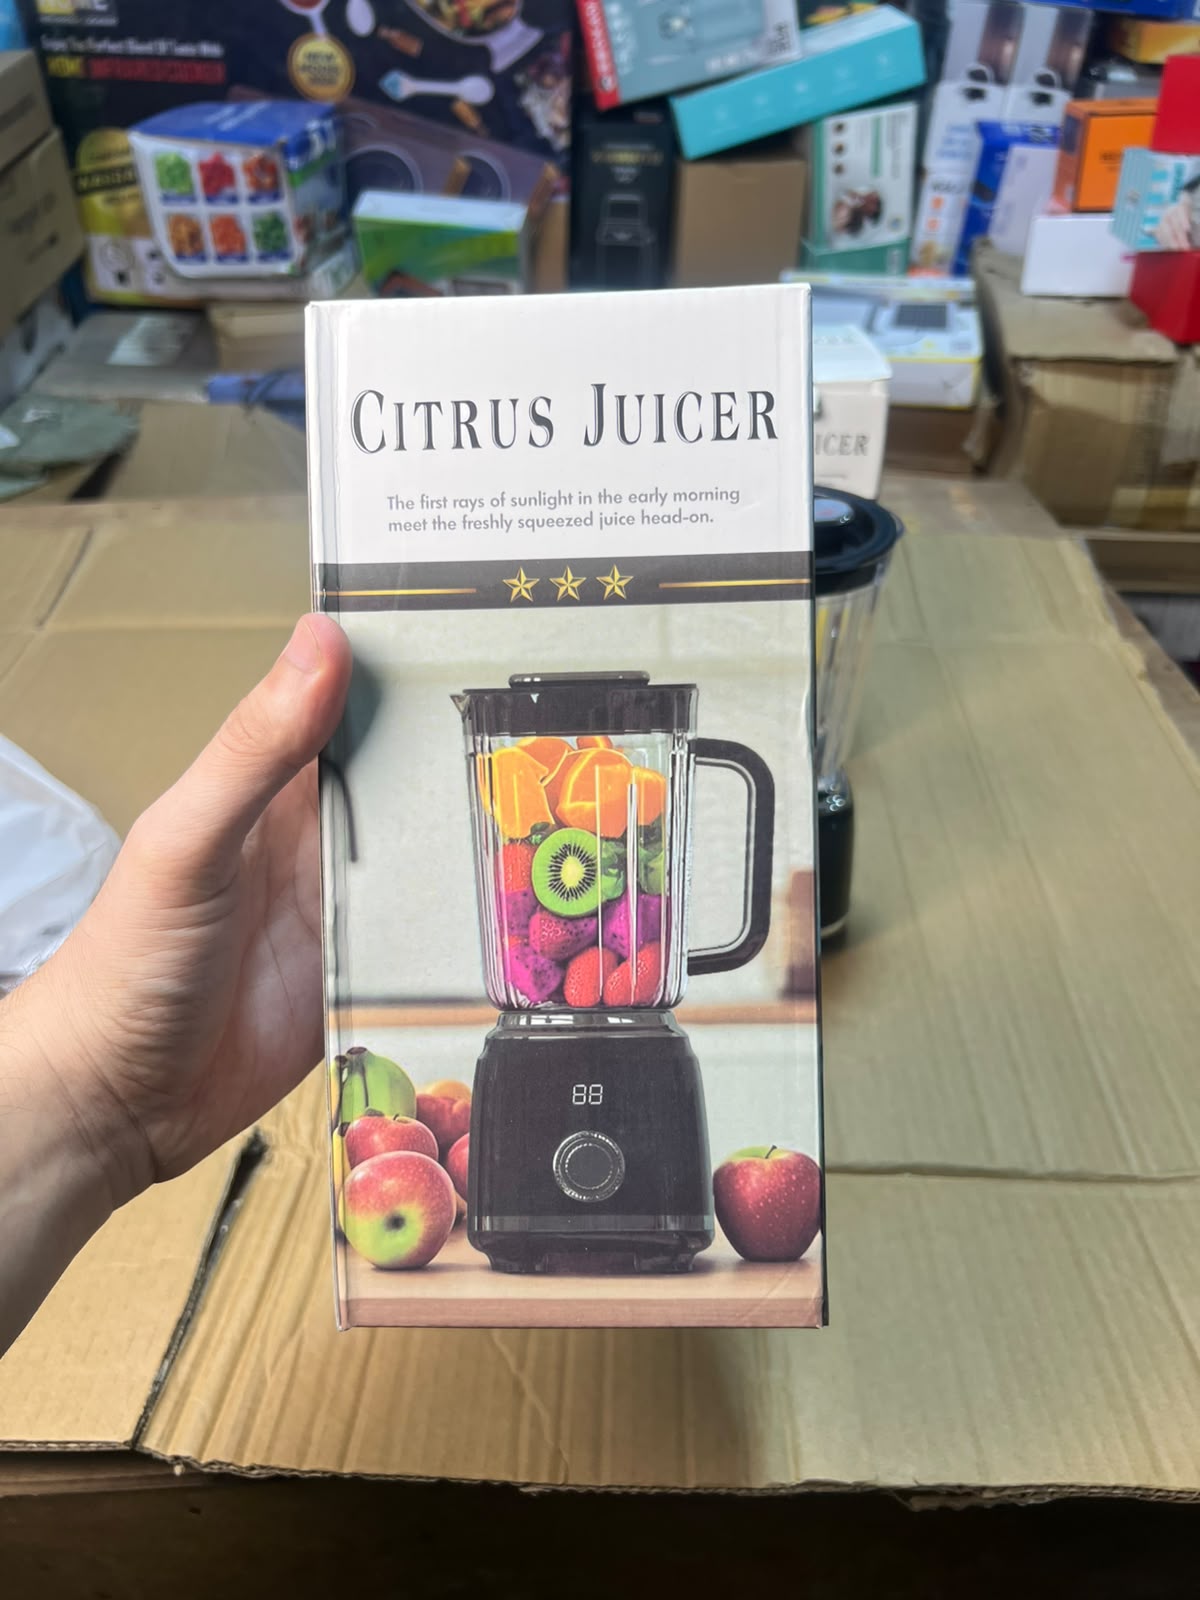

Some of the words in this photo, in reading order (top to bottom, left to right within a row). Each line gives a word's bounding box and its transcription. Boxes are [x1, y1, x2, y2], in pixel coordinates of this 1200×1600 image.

[350, 389, 554, 454] CITRUS
[583, 382, 779, 447] JUICER
[815, 432, 871, 456] ICER
[387, 494, 415, 510] The
[420, 493, 448, 510] first
[453, 498, 485, 513] rays
[490, 491, 506, 508] of
[510, 489, 574, 510] sunlight
[577, 491, 593, 505] in
[597, 488, 623, 504] the
[628, 486, 668, 507] early
[673, 486, 740, 505] morning
[388, 517, 429, 532] meet
[432, 515, 457, 531] the
[461, 513, 514, 534] freshly
[518, 510, 594, 533] squeezed
[598, 510, 636, 531] juice
[641, 507, 715, 525] head-on.
[572, 1083, 603, 1105] 88
